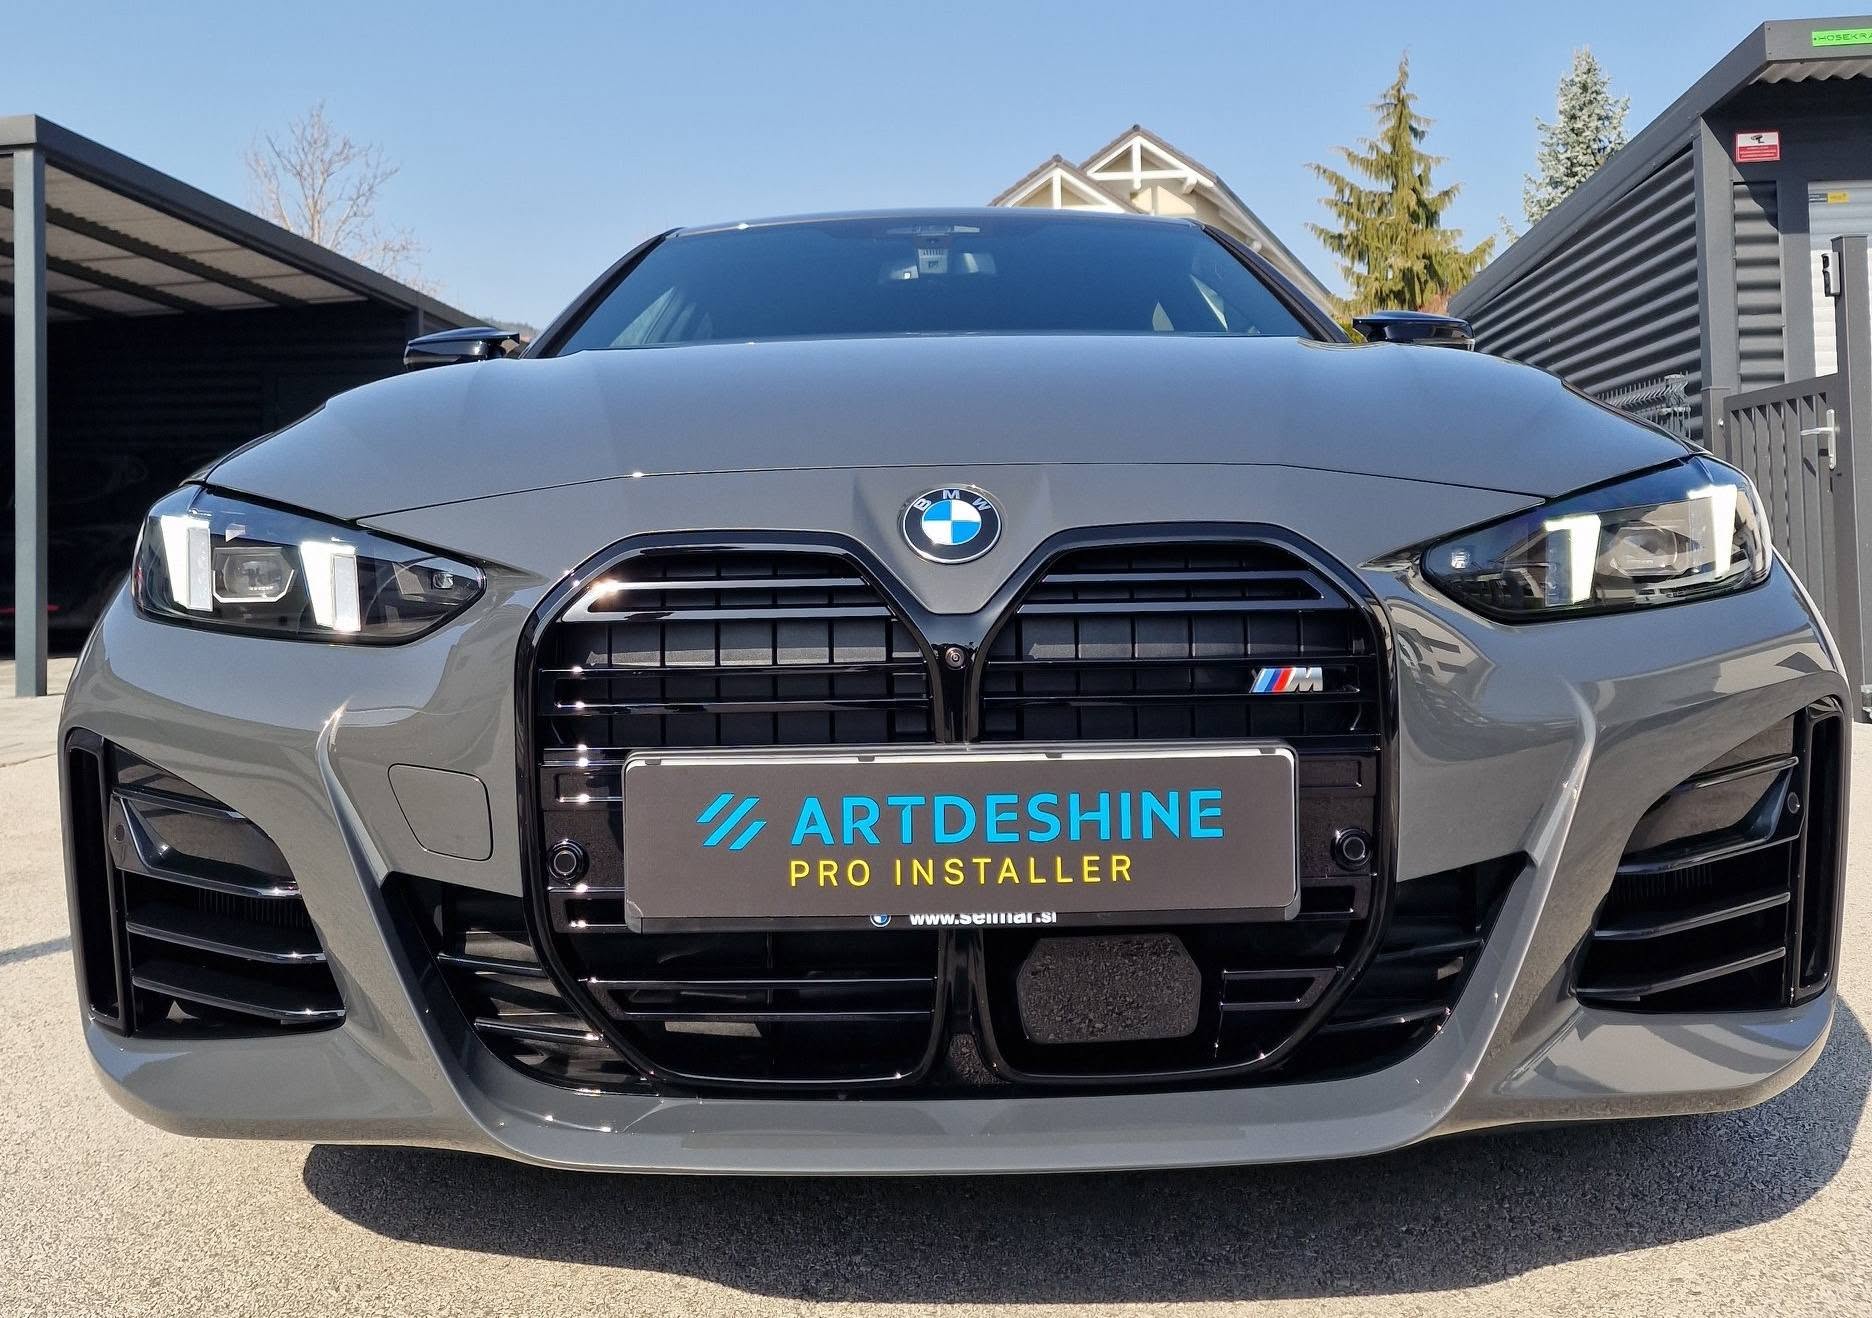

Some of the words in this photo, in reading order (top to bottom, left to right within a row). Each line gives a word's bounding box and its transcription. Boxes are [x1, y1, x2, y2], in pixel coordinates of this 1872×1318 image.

[913, 489, 991, 512] BMW
[791, 790, 1225, 846] ARTDESHINE
[790, 859, 871, 888] PRO
[895, 854, 1133, 887] INSTALLER
